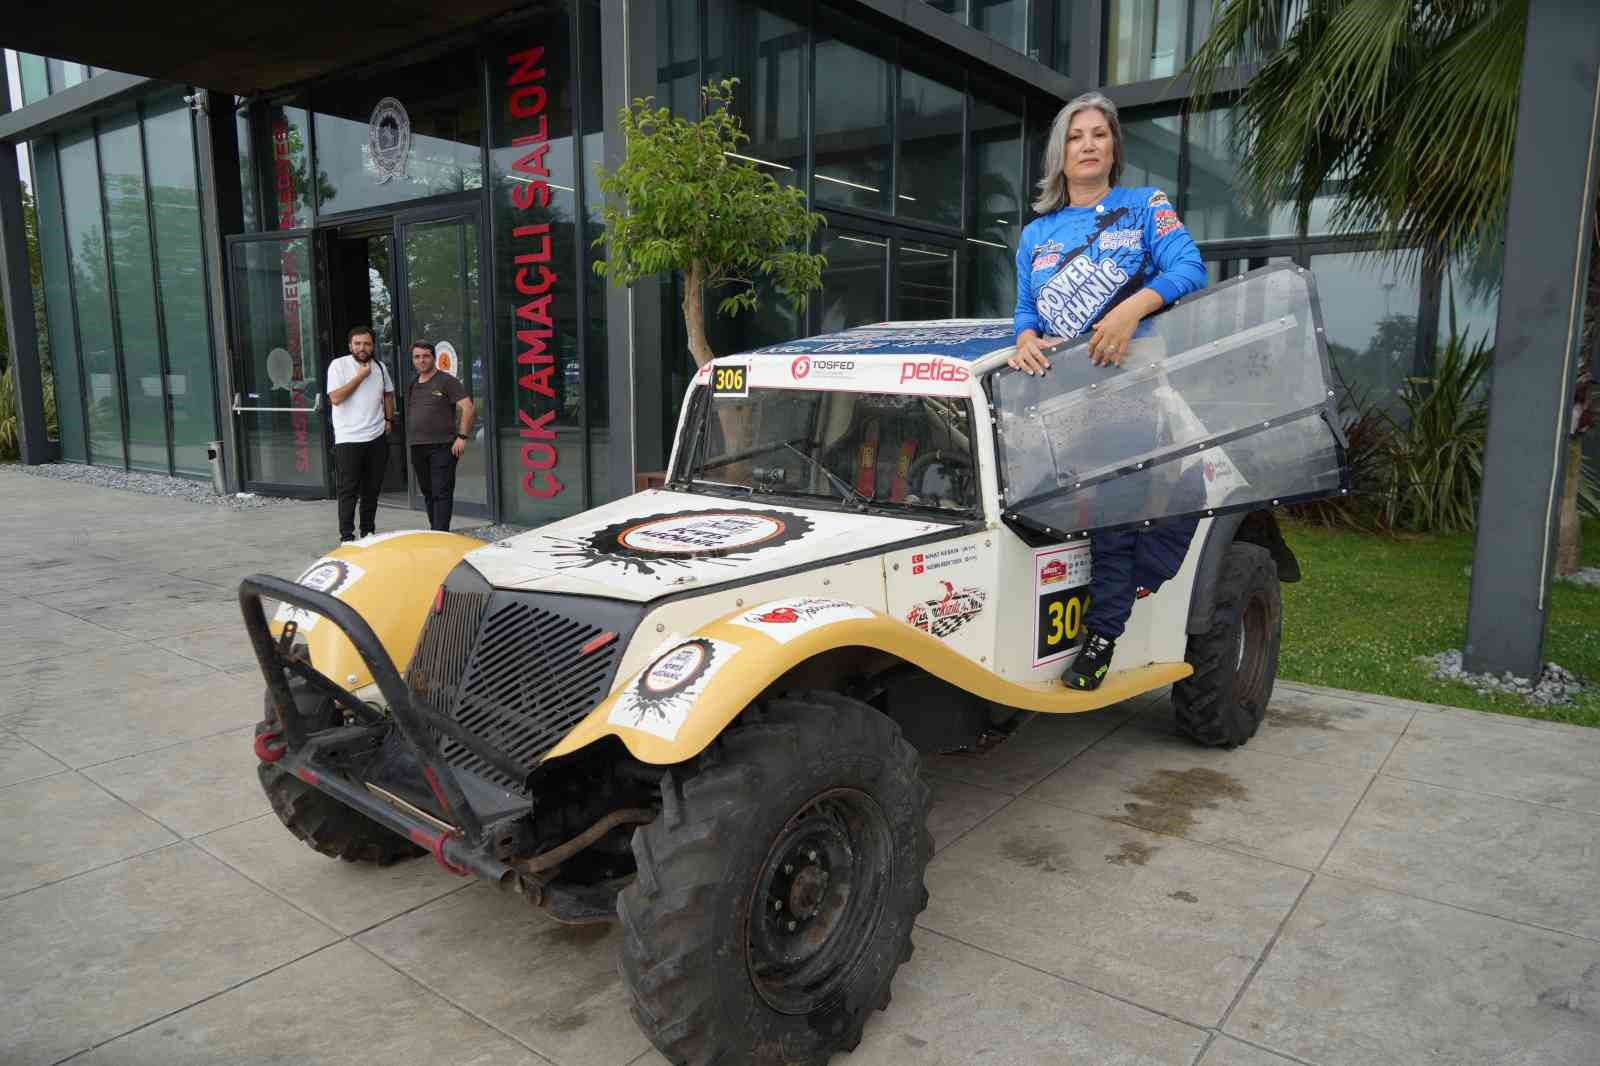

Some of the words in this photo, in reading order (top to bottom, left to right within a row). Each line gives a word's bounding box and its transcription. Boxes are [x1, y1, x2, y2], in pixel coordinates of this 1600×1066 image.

[509, 46, 551, 209] SALON
[513, 223, 558, 398] AMAÇLI
[1037, 255, 1098, 321] POWER
[1050, 257, 1129, 341] ECHANIC
[715, 368, 743, 391] 306
[812, 360, 855, 370] TOSFED
[900, 358, 970, 384] petlas
[519, 410, 564, 499] ÇOK
[1047, 597, 1089, 645] 30
